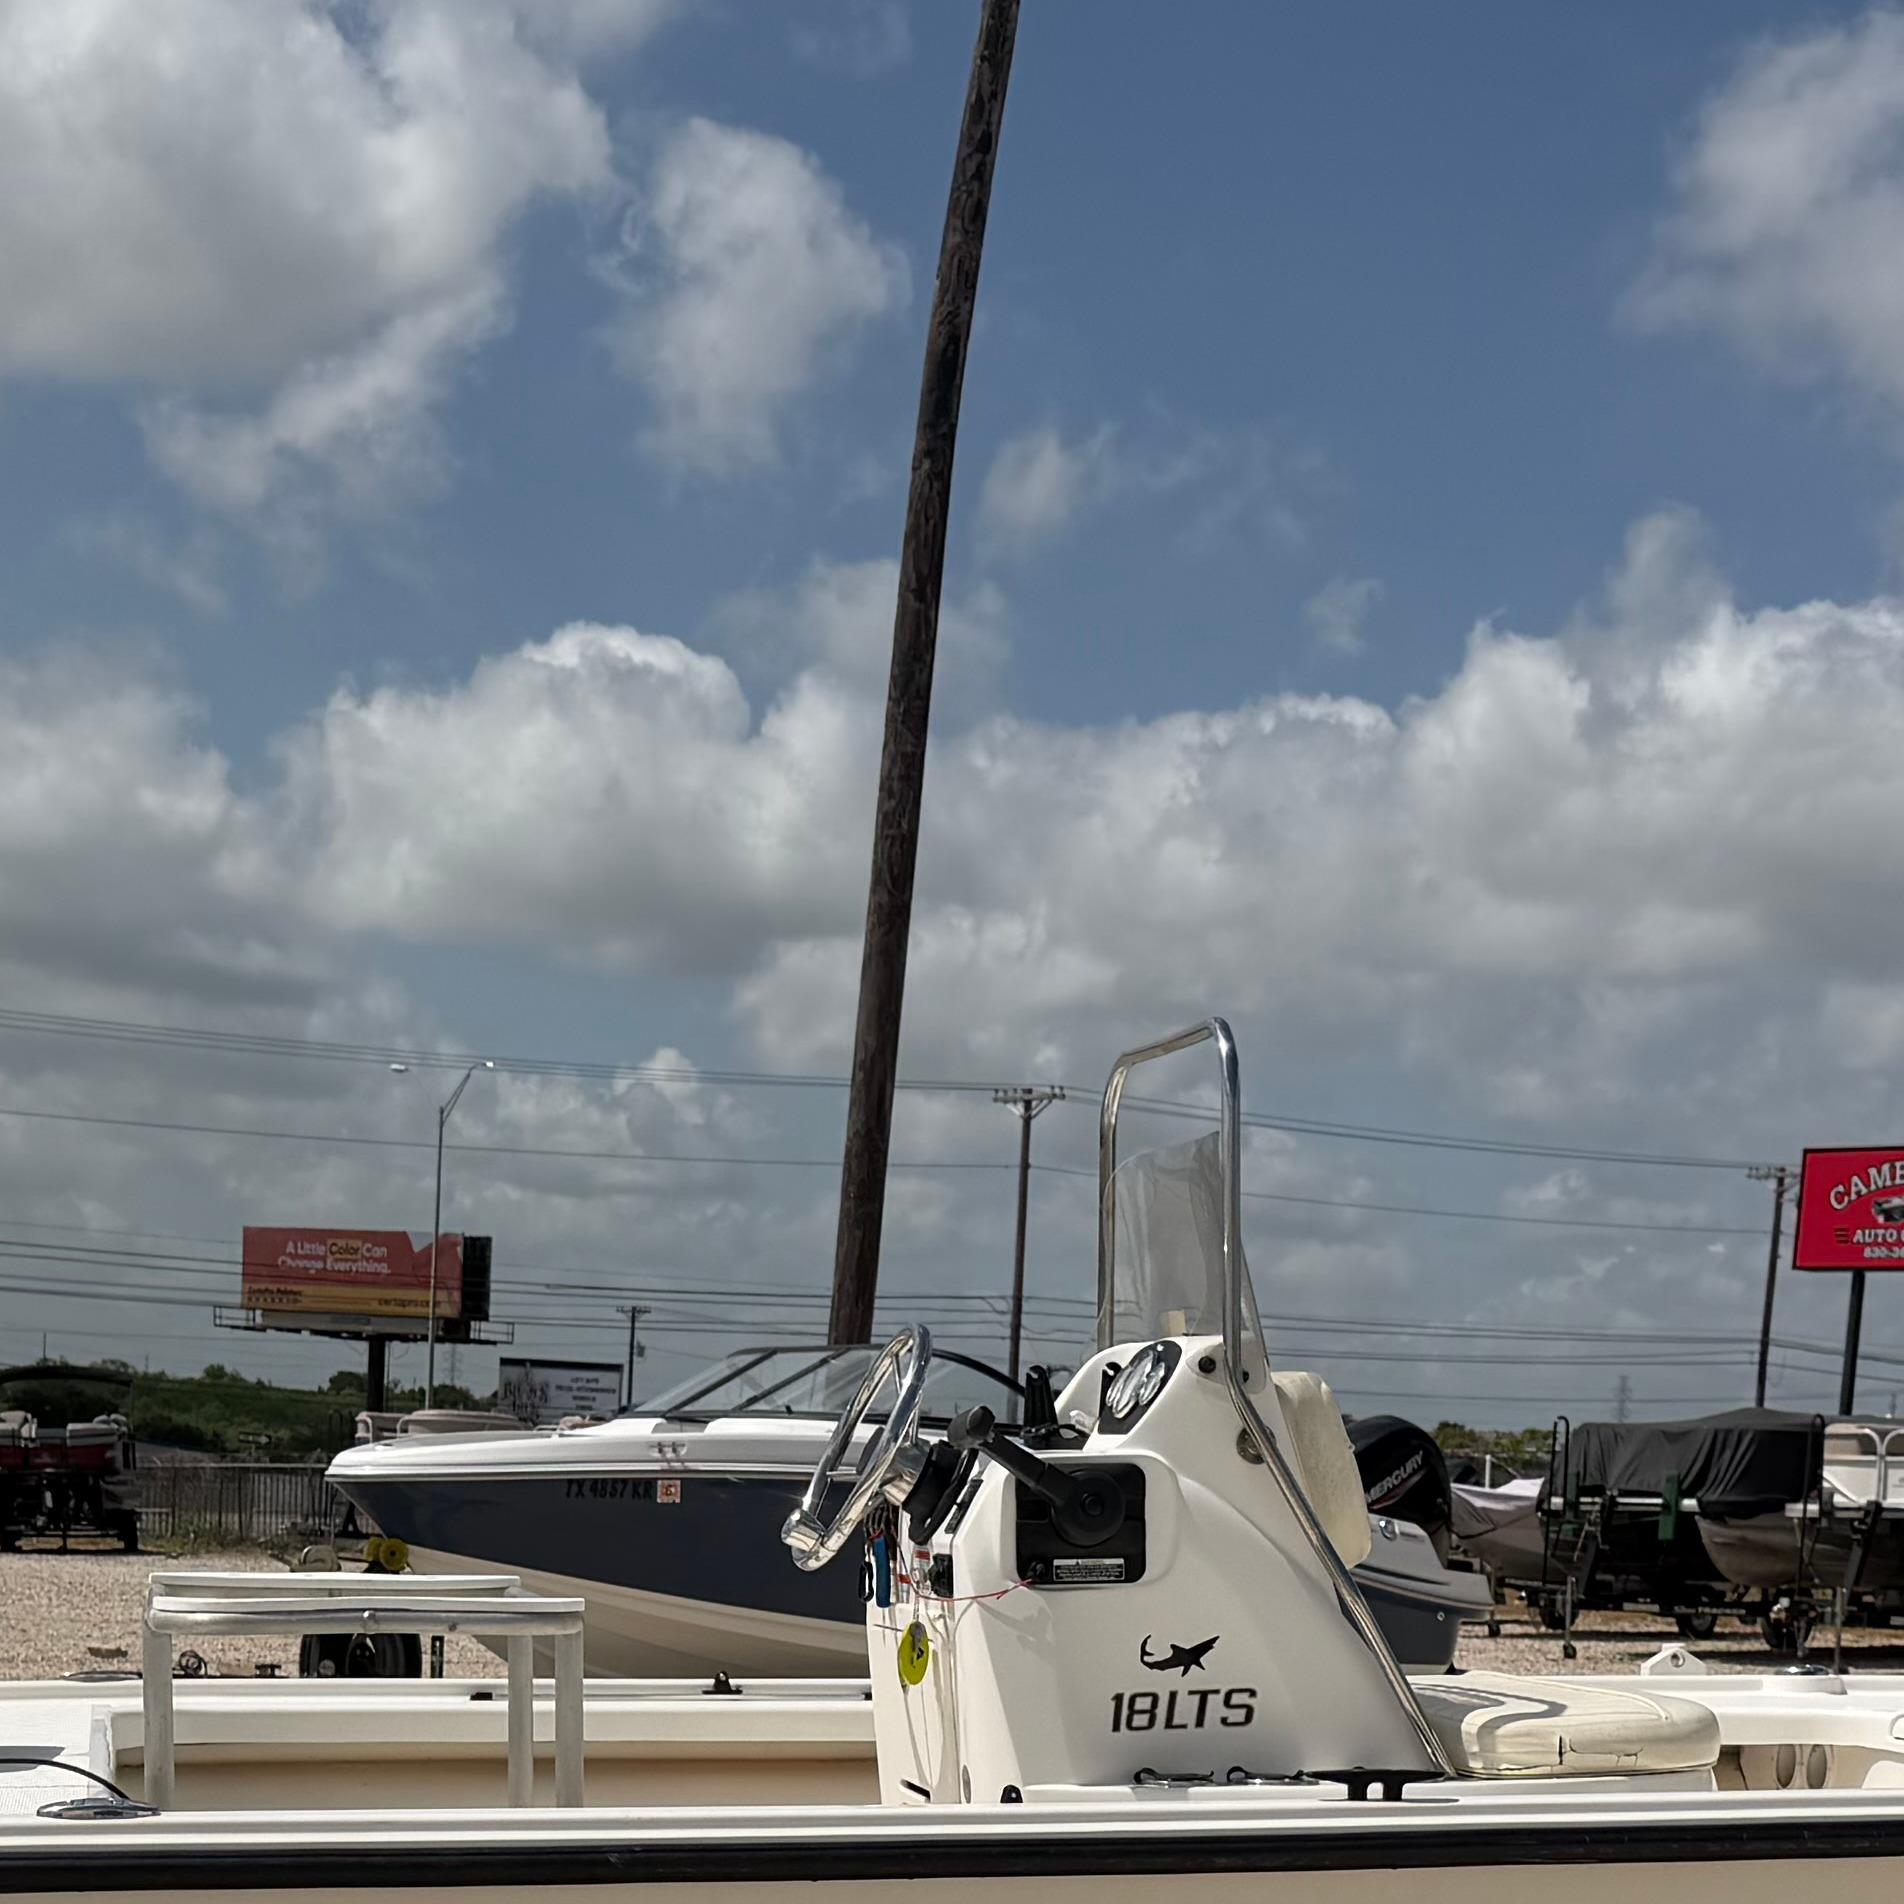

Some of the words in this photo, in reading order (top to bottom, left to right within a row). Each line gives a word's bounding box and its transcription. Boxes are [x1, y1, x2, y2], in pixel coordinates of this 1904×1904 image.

[1853, 1229, 1897, 1243] AUTO
[286, 1241, 296, 1255] A
[297, 1241, 326, 1255] Little
[329, 1242, 361, 1256] Color
[362, 1243, 388, 1257] Can
[326, 1256, 391, 1275] Everything.
[1110, 1688, 1258, 1732] 18LTS
